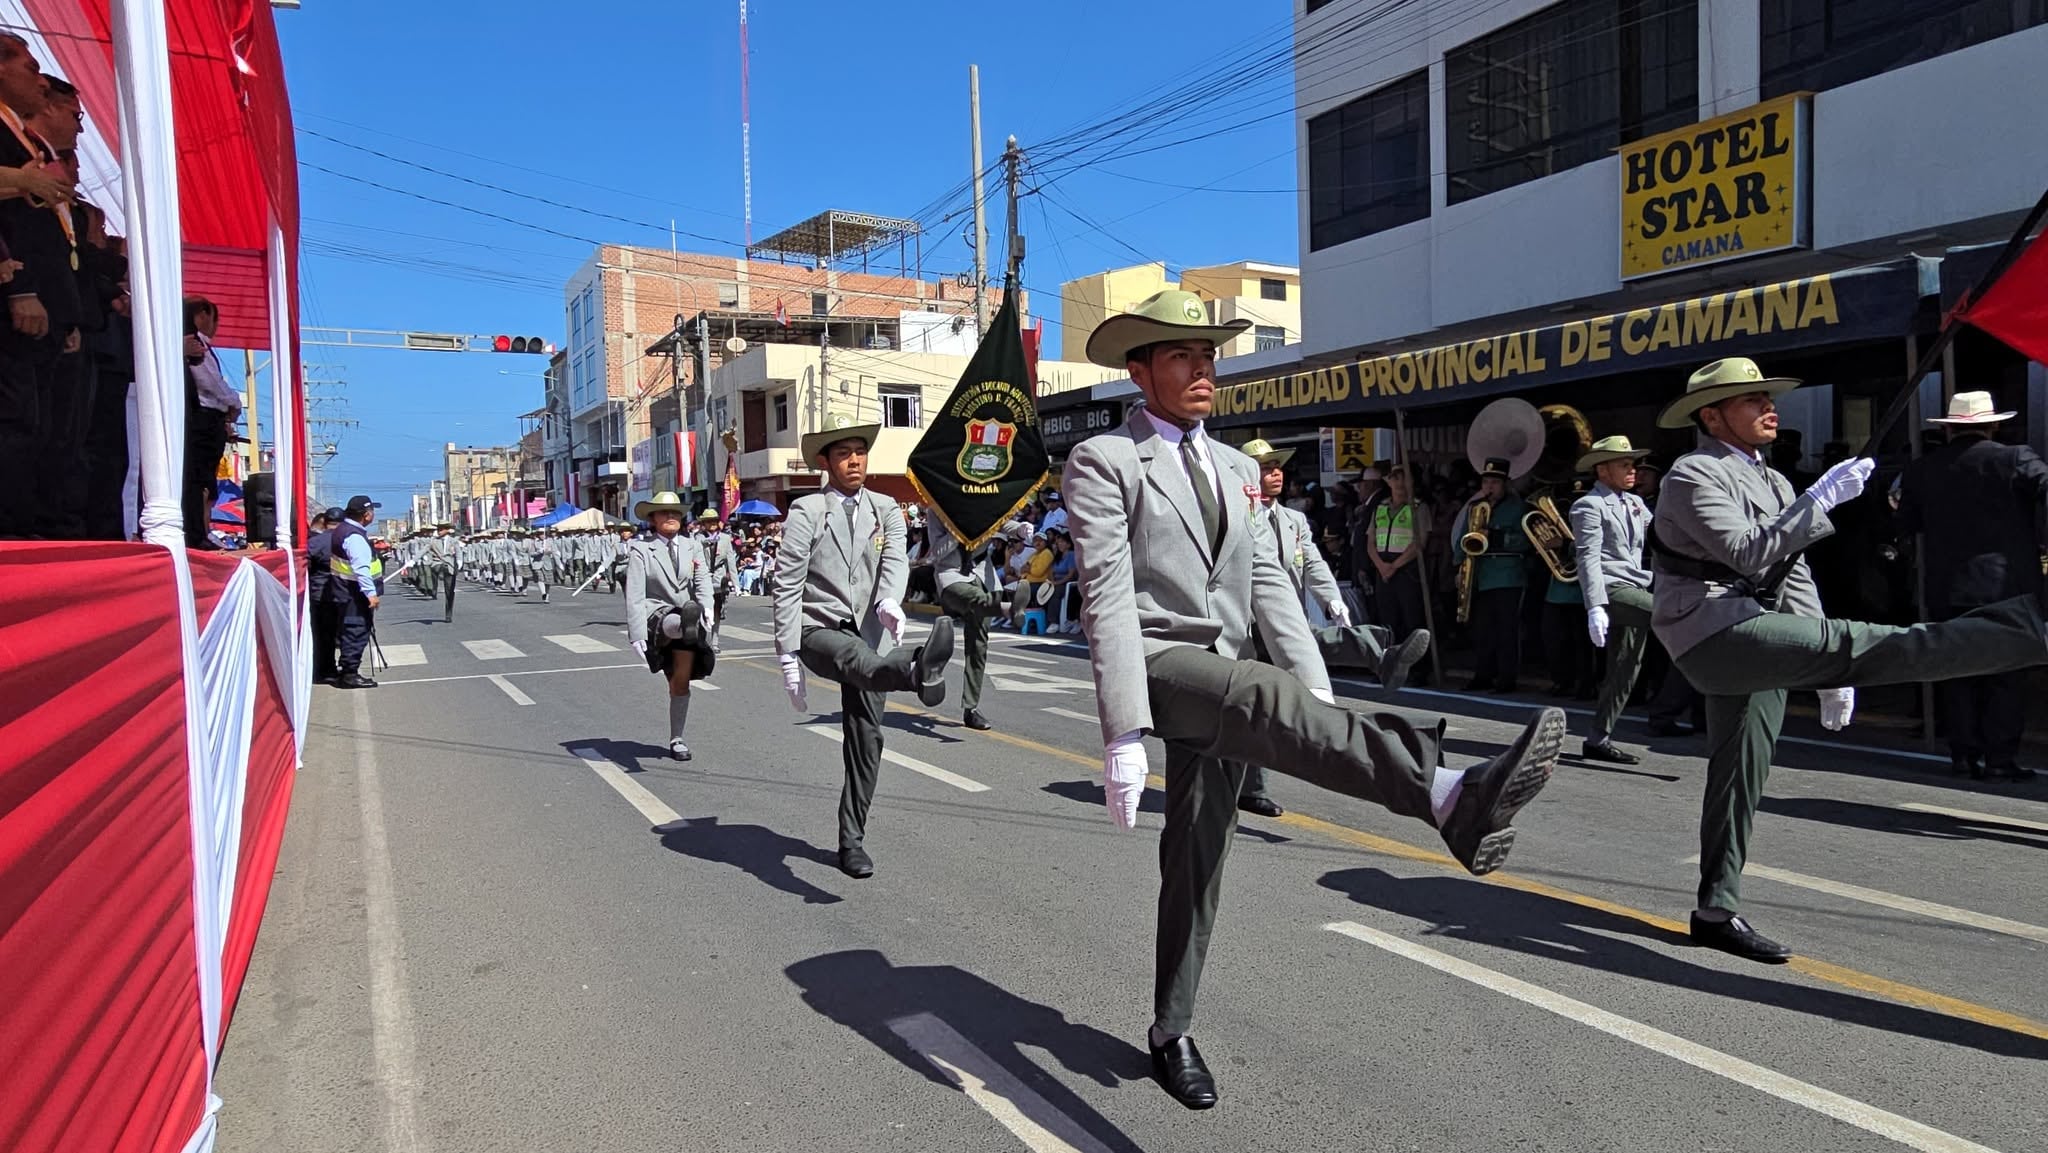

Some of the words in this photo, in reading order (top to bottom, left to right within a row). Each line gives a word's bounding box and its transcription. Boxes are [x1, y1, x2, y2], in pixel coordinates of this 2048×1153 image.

[1626, 113, 1790, 194] HOTEL
[1641, 172, 1771, 239] STAR
[1661, 226, 1744, 266] CAMANÁ
[1211, 364, 1350, 418] NICIPALIDAD
[1359, 331, 1546, 397] PROVINCIAL
[1560, 315, 1612, 367] DE
[1043, 415, 1073, 435] #BIG
[1087, 408, 1111, 429] BIG
